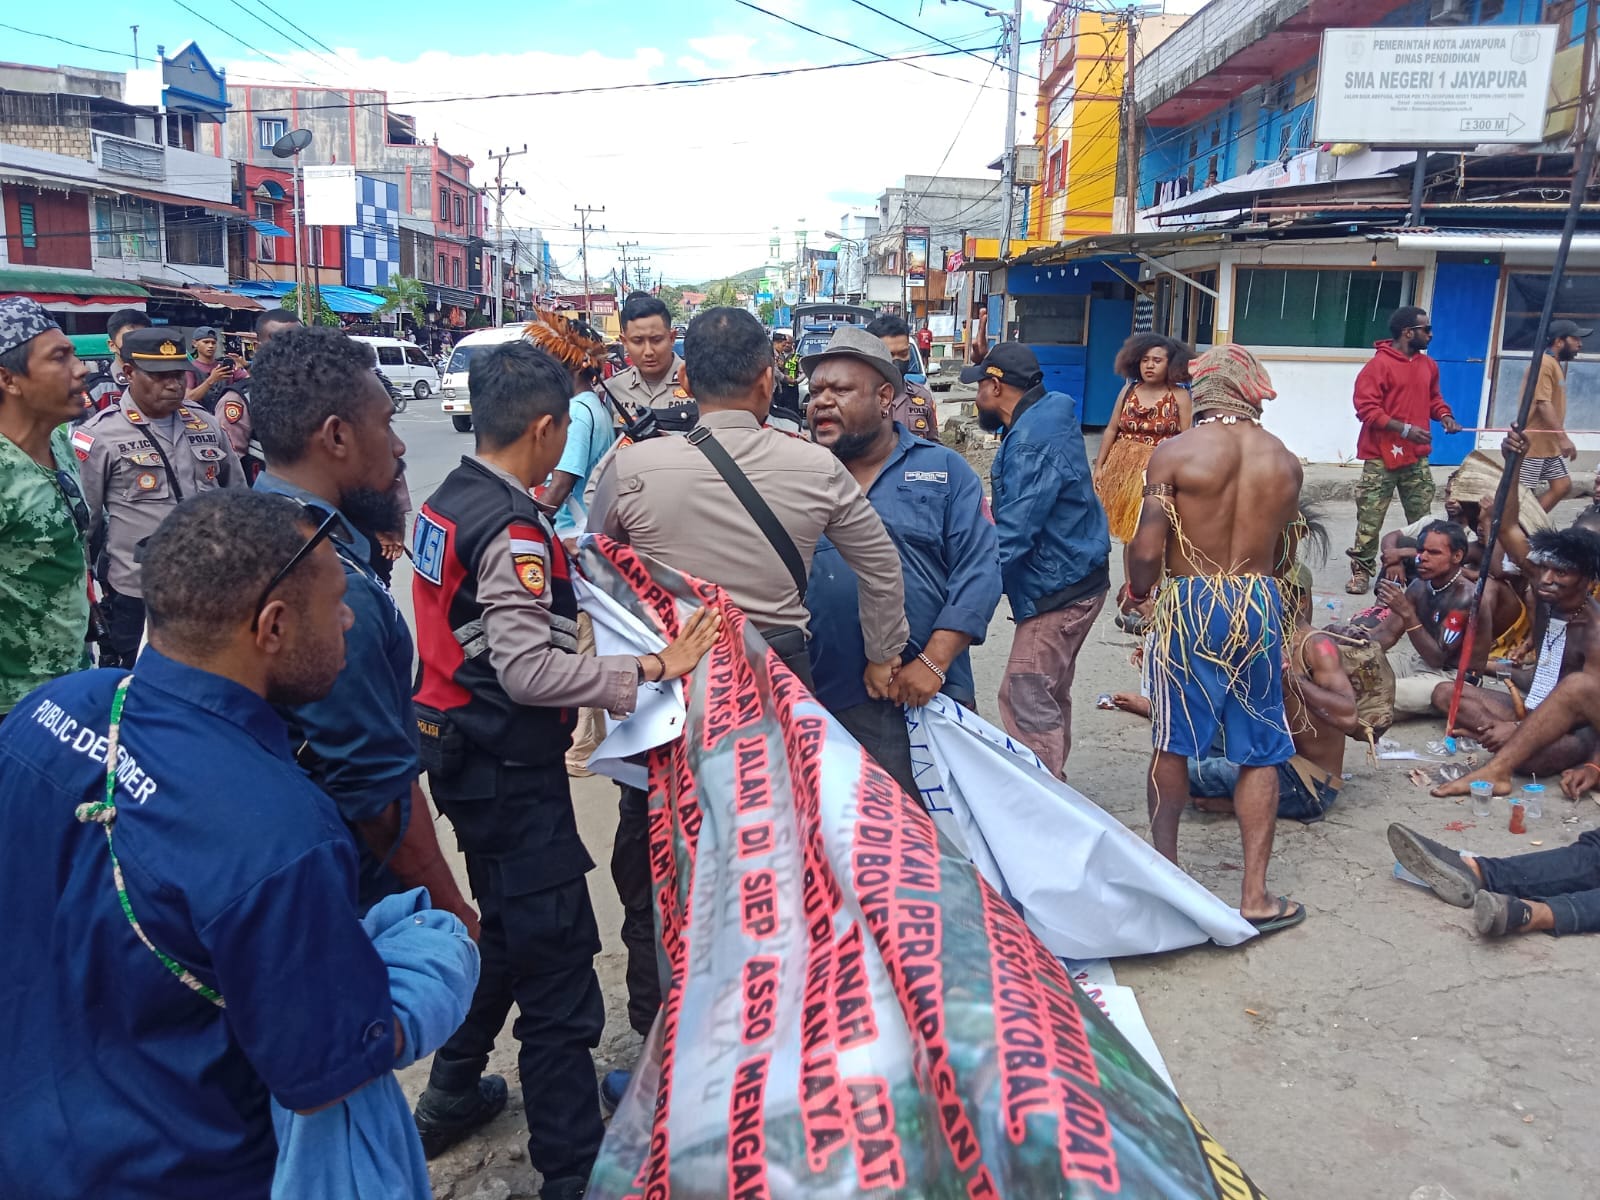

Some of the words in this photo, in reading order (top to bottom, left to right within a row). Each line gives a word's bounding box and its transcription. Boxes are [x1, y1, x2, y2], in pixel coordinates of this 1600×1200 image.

[1344, 71, 1376, 89] SMA
[1379, 71, 1434, 89] NEGERI
[1438, 71, 1446, 89] 1
[1451, 70, 1528, 88] JAYAPURA
[1373, 39, 1431, 50] PEMERINTAH
[1433, 39, 1457, 50] KOTA
[1459, 38, 1506, 50] JAYAPURA
[1395, 53, 1423, 64] DINAS
[1424, 52, 1480, 64] PENDIDIKAN
[1494, 120, 1505, 130] M
[187, 434, 217, 444] POLRI
[417, 720, 439, 738] POLISI
[707, 670, 733, 747] PAKSA.
[31, 699, 78, 743] PUBLIC
[72, 727, 158, 805] DEENDER
[738, 738, 764, 812] JALAN
[742, 825, 770, 855] DI
[858, 825, 893, 849] DI
[899, 788, 936, 888] LAKUKAN
[744, 872, 776, 938] SIEP
[809, 917, 833, 957] DI
[746, 960, 776, 1042] ASSO
[803, 952, 834, 1050] INTAN
[836, 925, 877, 1046] TANAH
[897, 903, 977, 1166] PERAMPASAN
[1043, 986, 1097, 1083] TANAH
[802, 1055, 846, 1167] JAYA.
[848, 1084, 900, 1186] ADAT
[1062, 1084, 1114, 1186] ADAT
